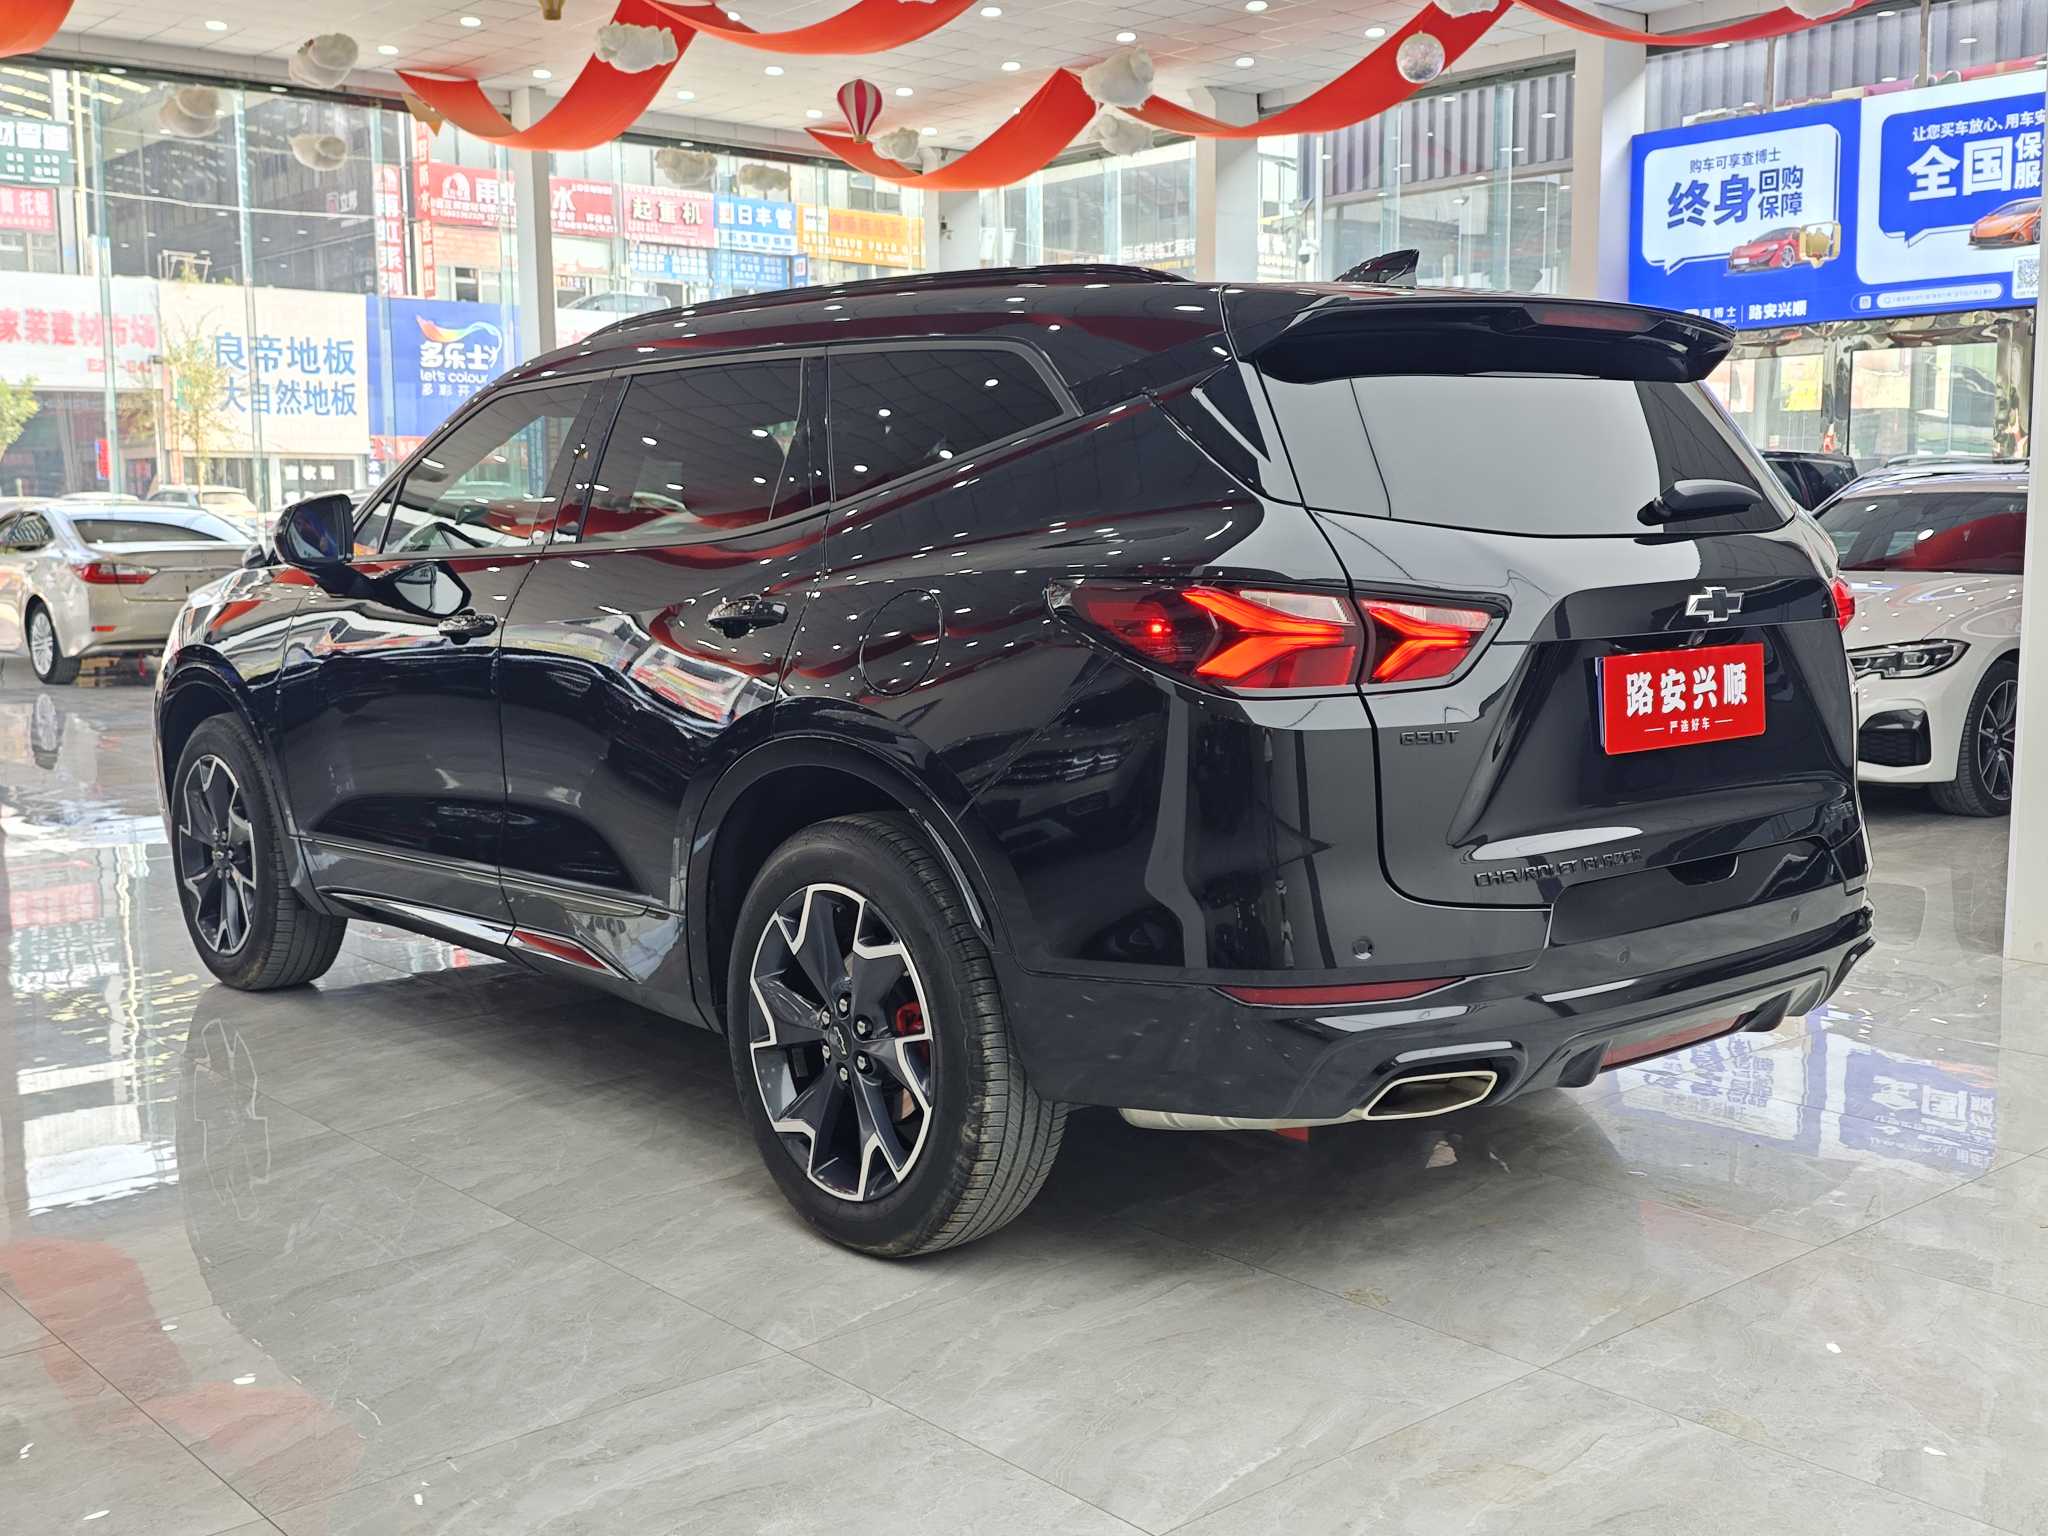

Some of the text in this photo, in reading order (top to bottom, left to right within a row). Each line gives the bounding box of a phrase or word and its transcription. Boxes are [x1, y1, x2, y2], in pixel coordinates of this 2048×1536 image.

[1690, 147, 1781, 174] 购车可享查博士
[1906, 135, 2013, 200] 全国
[632, 196, 703, 225] 起重机
[1667, 165, 1804, 229] 终身 回购
[1758, 192, 1803, 220] 保障
[1749, 300, 1807, 320] 路安兴顺
[420, 340, 489, 371] 多乐士
[420, 370, 488, 384] let's colour
[219, 376, 358, 416] 大自然地板
[1626, 662, 1748, 717] 路安兴顺
[1669, 716, 1711, 734] 严选好车
[1474, 848, 1641, 888] CHEVROLET BLAZER
